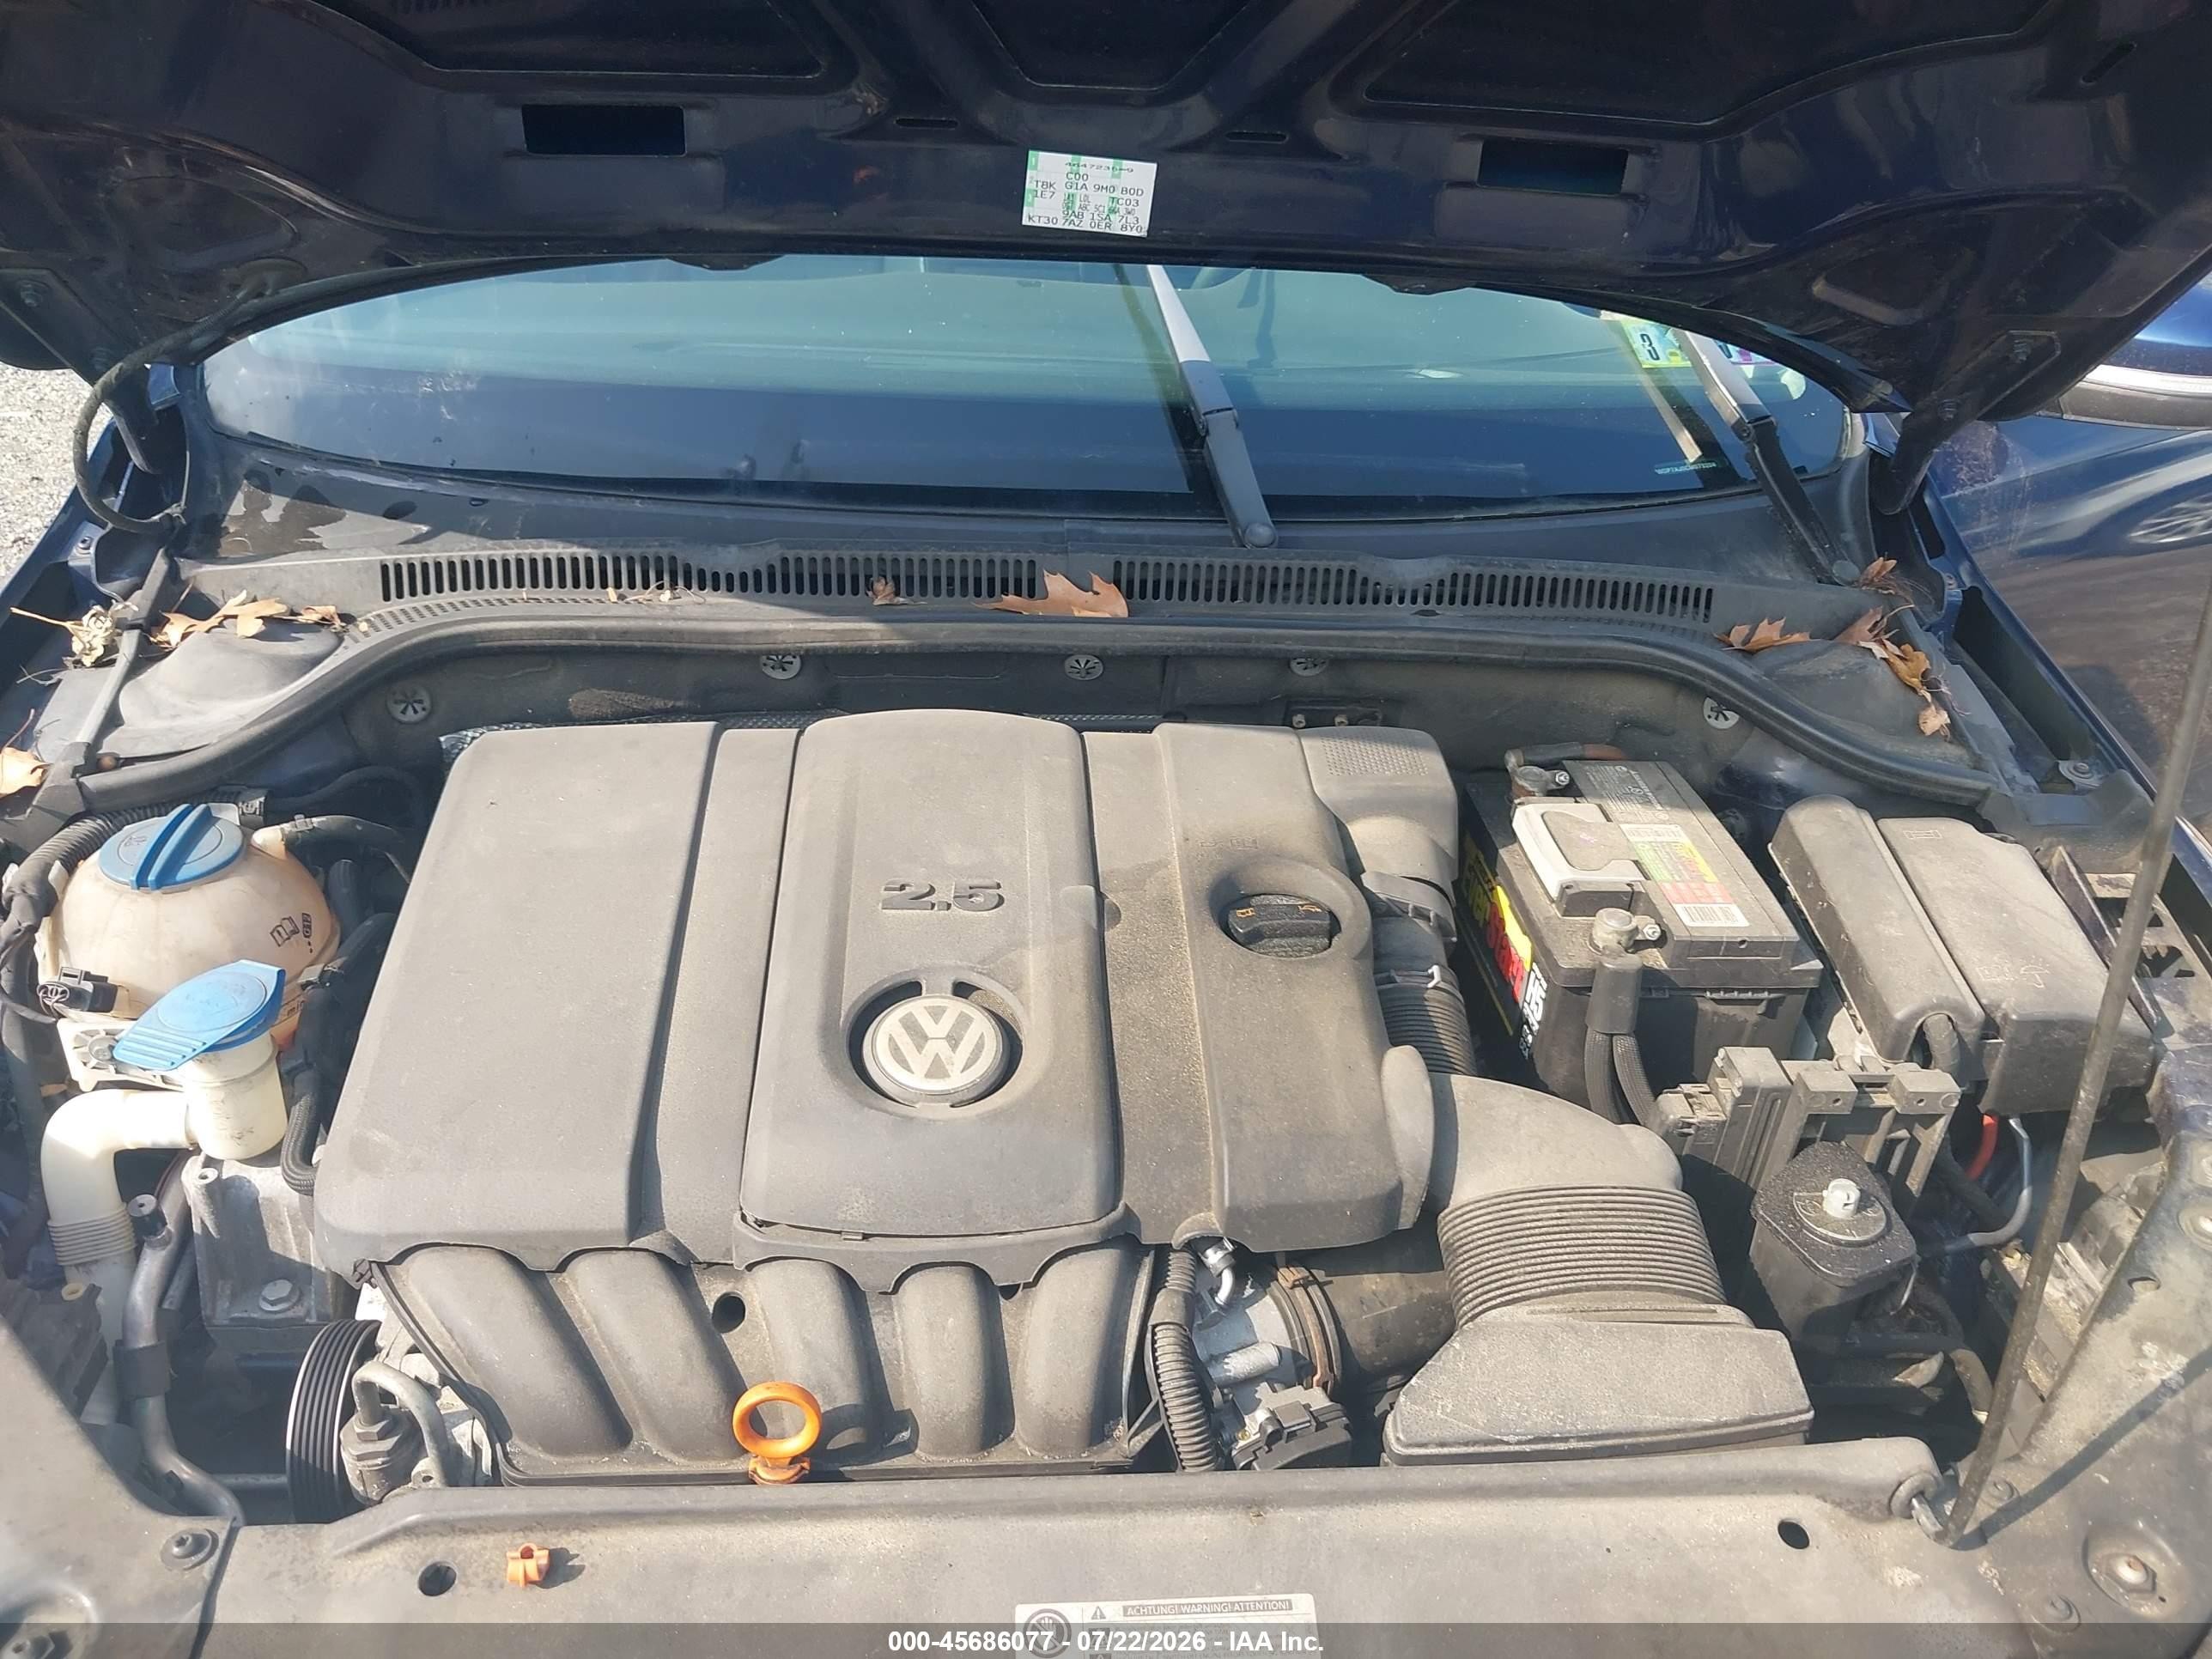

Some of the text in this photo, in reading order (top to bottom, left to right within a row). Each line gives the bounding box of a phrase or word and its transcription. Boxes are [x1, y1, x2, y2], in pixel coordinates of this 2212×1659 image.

[1034, 179, 1056, 190] T8K
[1065, 181, 1088, 191] G1A
[1034, 190, 1055, 199] 1E7
[1028, 213, 1058, 226] KT30
[1062, 219, 1083, 228] 7AZ
[1062, 210, 1084, 220] 9AB
[1118, 216, 1139, 226] 7L3
[1640, 333, 1660, 361] 3
[881, 878, 1006, 913] 2.5
[1127, 1600, 1290, 1617] ACHTUNG! WARNING! ATTENTION!
